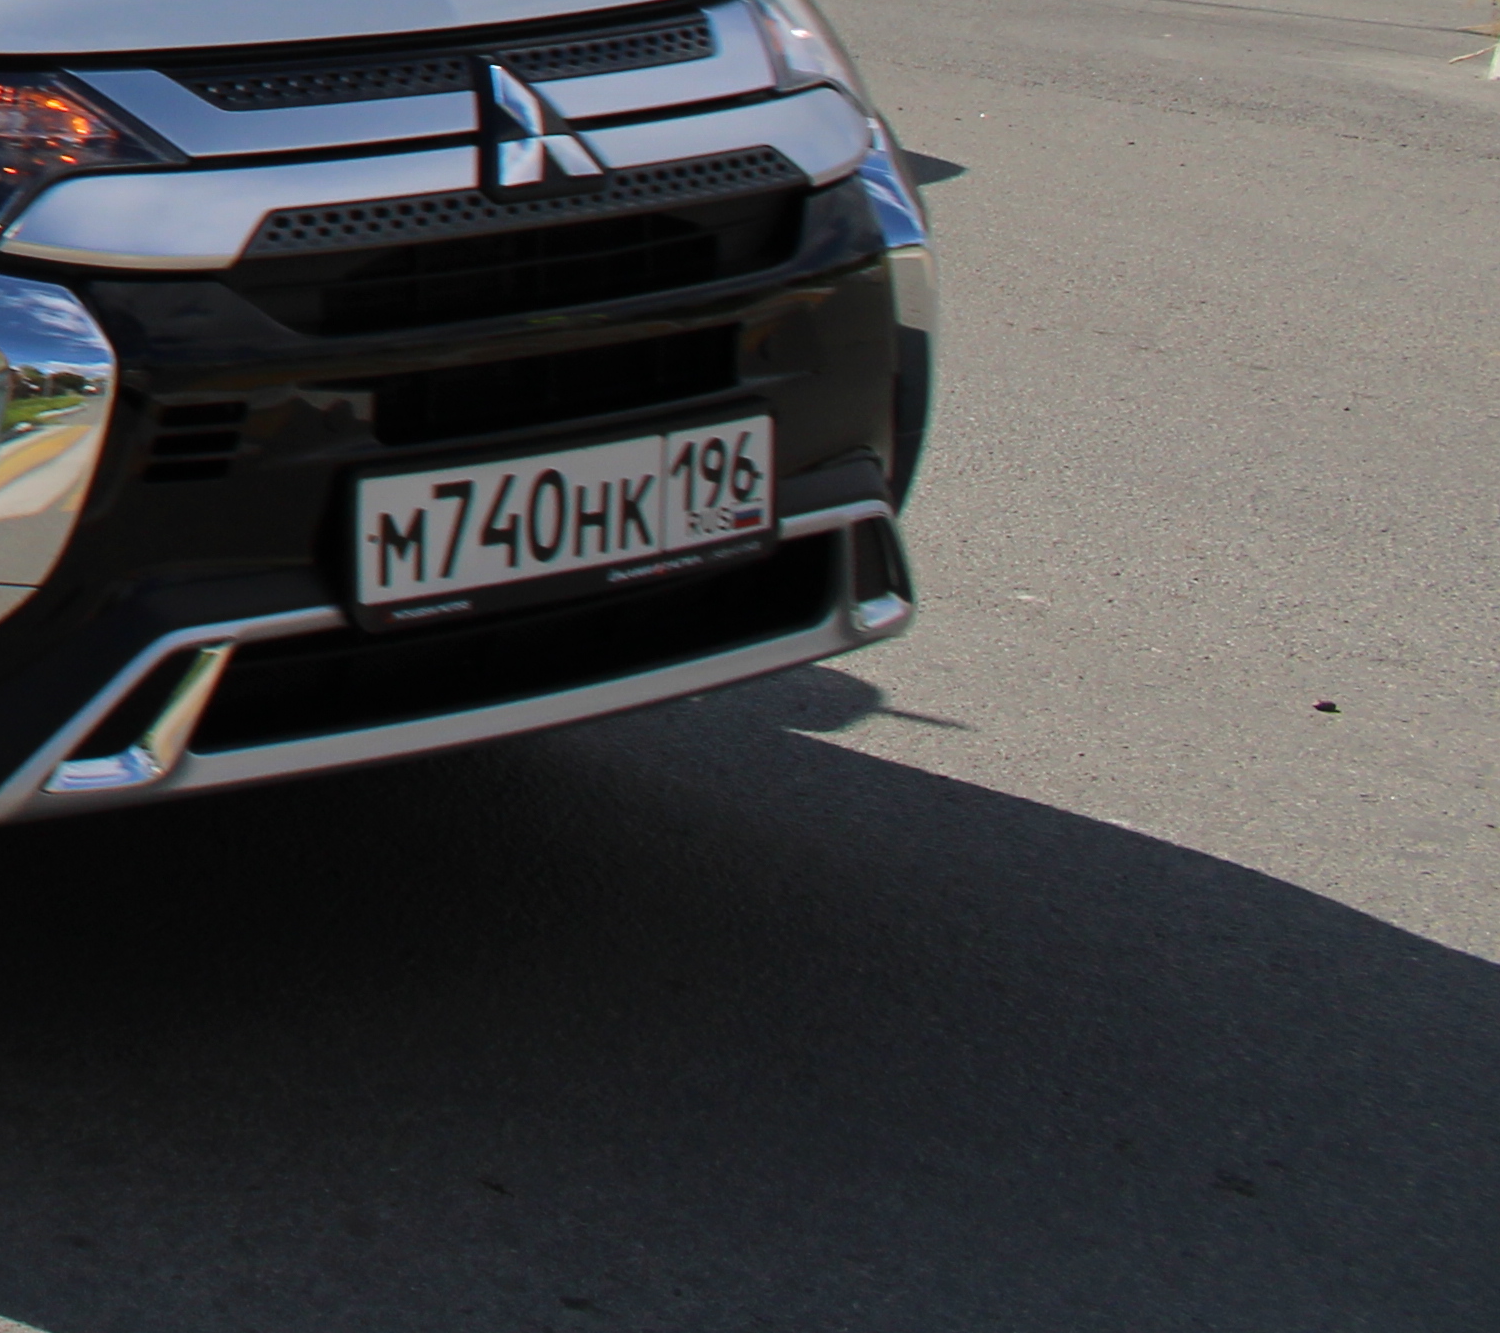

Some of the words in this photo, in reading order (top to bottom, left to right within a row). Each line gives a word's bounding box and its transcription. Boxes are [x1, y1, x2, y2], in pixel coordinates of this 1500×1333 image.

[378, 468, 657, 588] М740НК
[670, 430, 757, 512] 196
[686, 505, 732, 536] RUS
